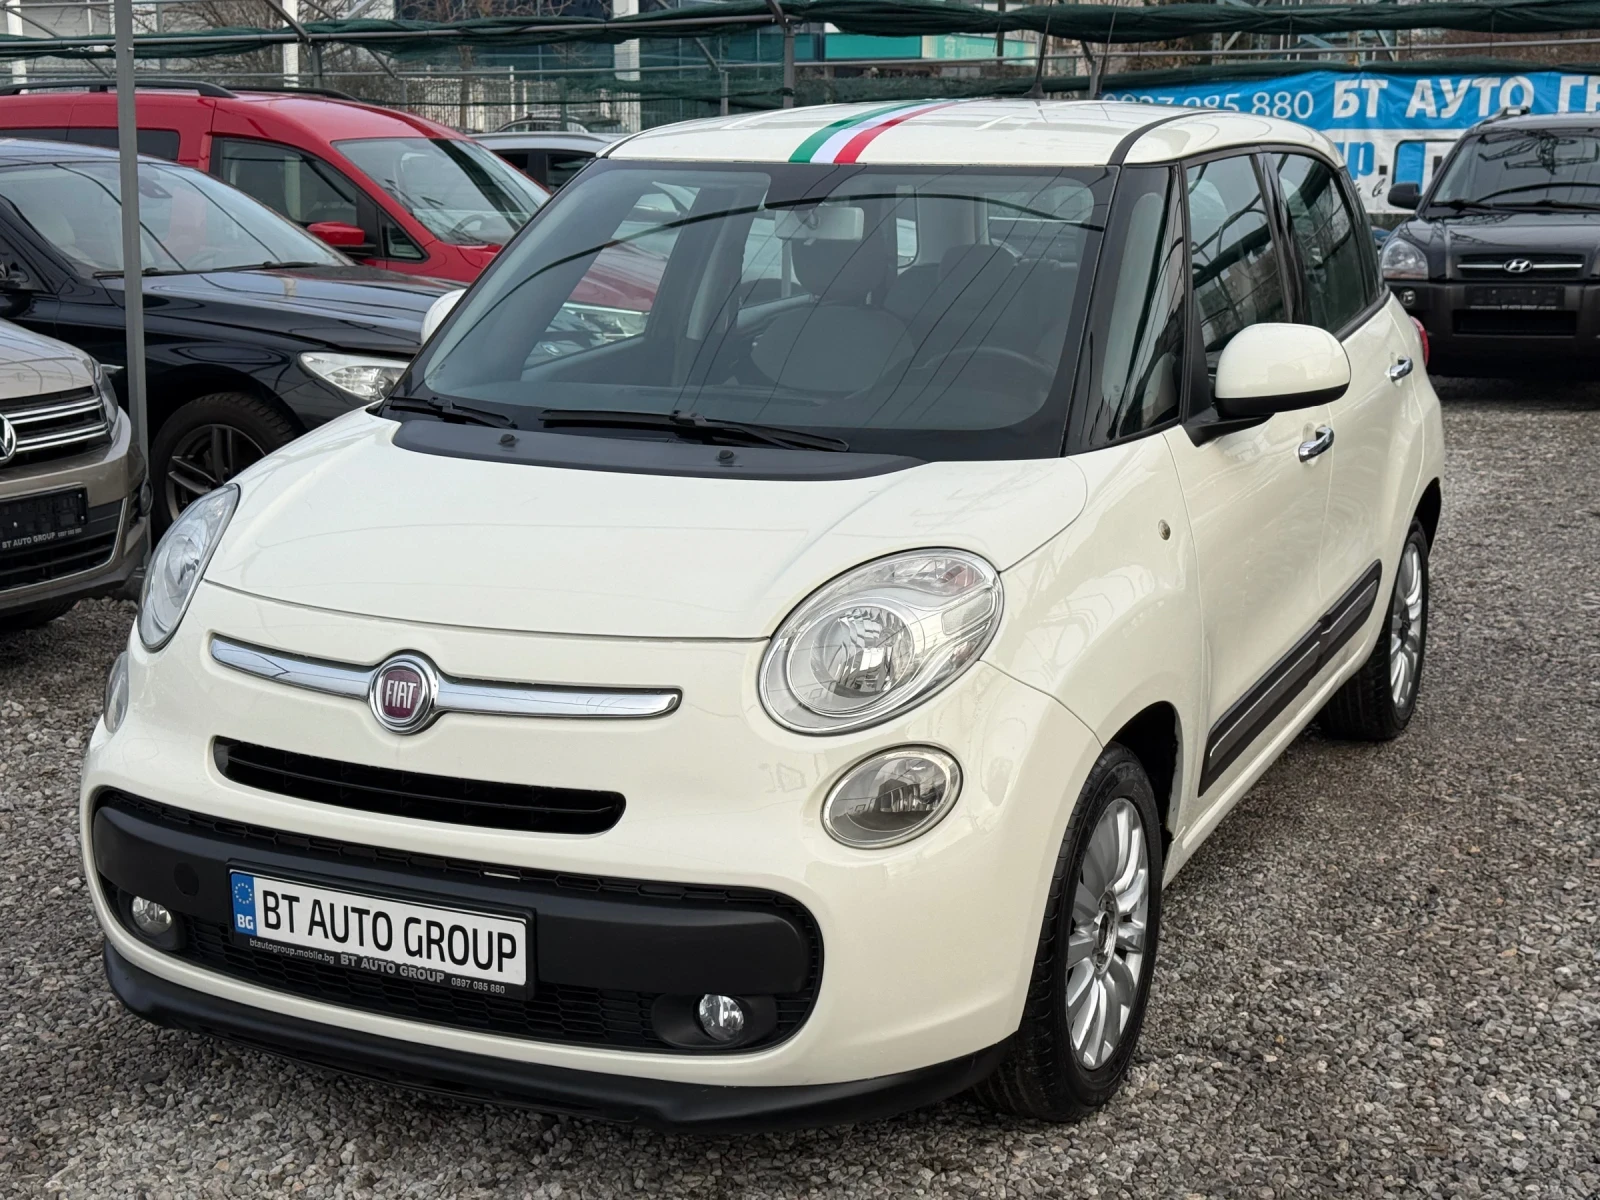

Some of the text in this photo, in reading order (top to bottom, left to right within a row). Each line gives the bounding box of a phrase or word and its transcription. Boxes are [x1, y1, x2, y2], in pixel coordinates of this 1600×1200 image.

[1251, 90, 1314, 119] 880
[1332, 79, 1388, 119] БТ
[1405, 75, 1535, 119] АУТО
[13, 537, 32, 547] AUTO
[33, 532, 56, 542] GROUP
[385, 679, 417, 709] FIAT
[237, 913, 254, 930] BG
[262, 889, 517, 973] BT AUTO GROUP
[249, 938, 505, 994] btautogroup.mobile.bg BT AUTO GROUP 0897 085 880
